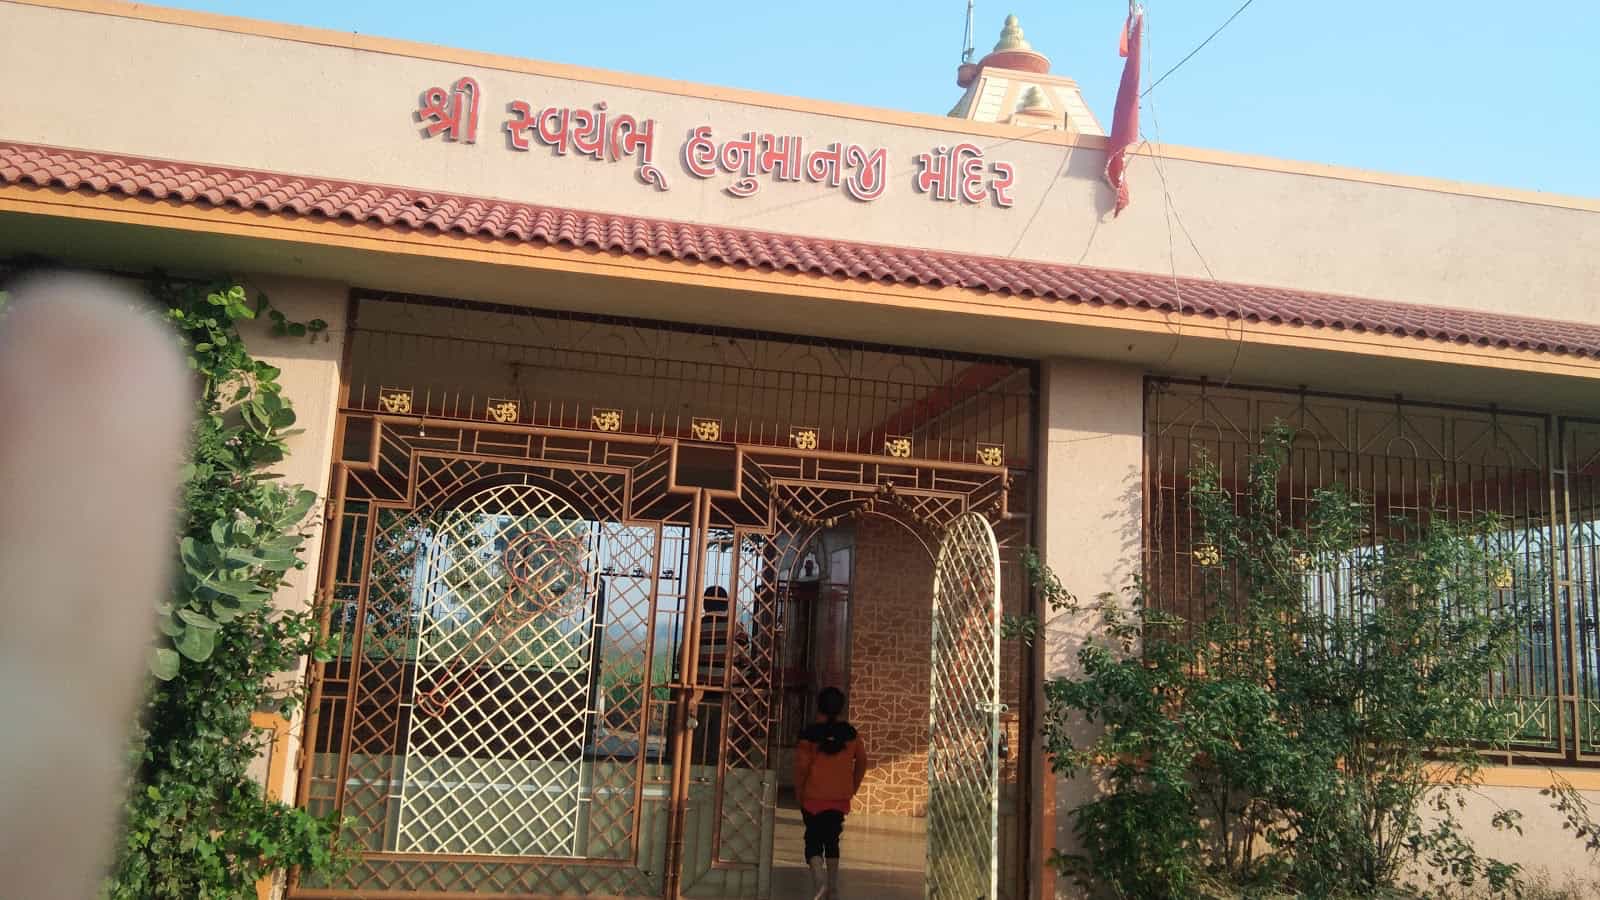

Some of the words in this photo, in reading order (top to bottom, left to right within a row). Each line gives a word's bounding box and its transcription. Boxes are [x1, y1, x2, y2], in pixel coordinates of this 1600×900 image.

[416, 77, 479, 143] શ્રી
[507, 100, 669, 191] સ્વયંભૂ
[685, 126, 888, 201] હનુમાનજી
[917, 143, 1015, 206] મંદિર
